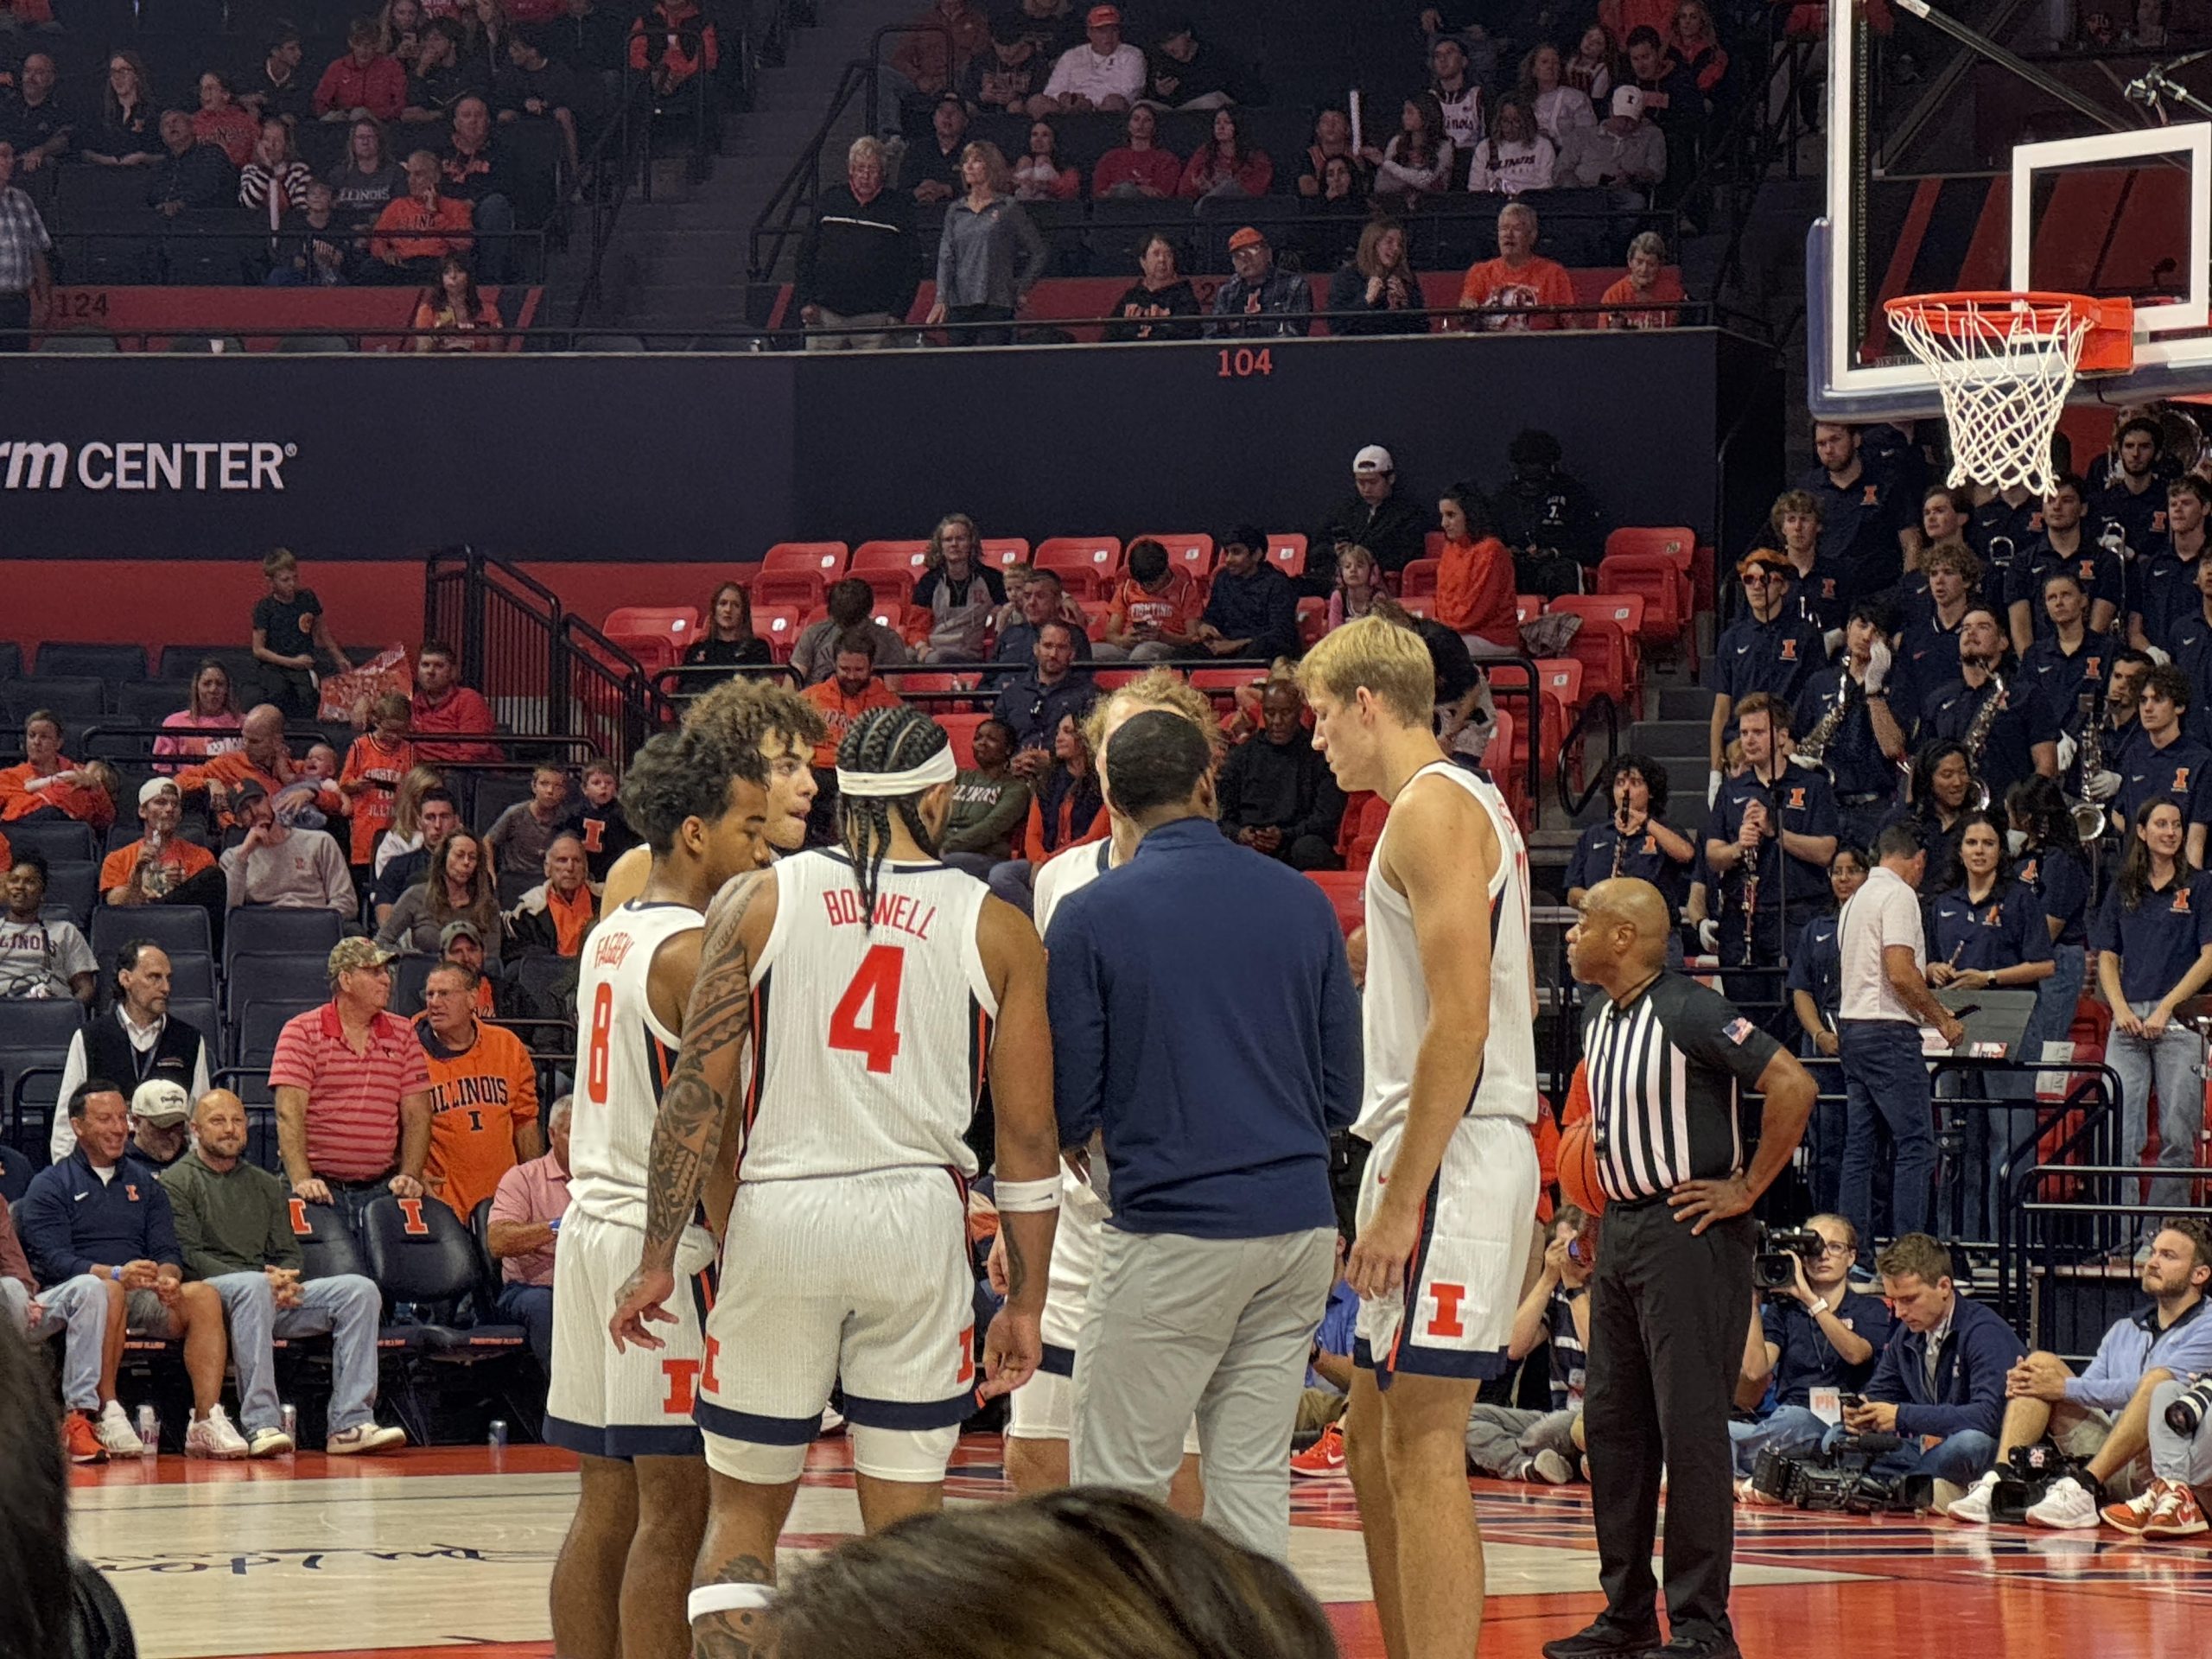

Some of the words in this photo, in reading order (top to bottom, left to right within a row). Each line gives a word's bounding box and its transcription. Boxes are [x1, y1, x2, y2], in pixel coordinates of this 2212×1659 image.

[55, 293, 110, 317] 124
[1218, 348, 1273, 376] 104
[582, 817, 606, 853] I
[0, 933, 57, 957] LINOS
[828, 944, 905, 1074] 4
[588, 982, 613, 1104] 8
[432, 1075, 508, 1115] ILLINOIS
[467, 1110, 483, 1131] I
[397, 1198, 429, 1235] I
[1427, 1283, 1465, 1338] I
[662, 1358, 700, 1414] I
